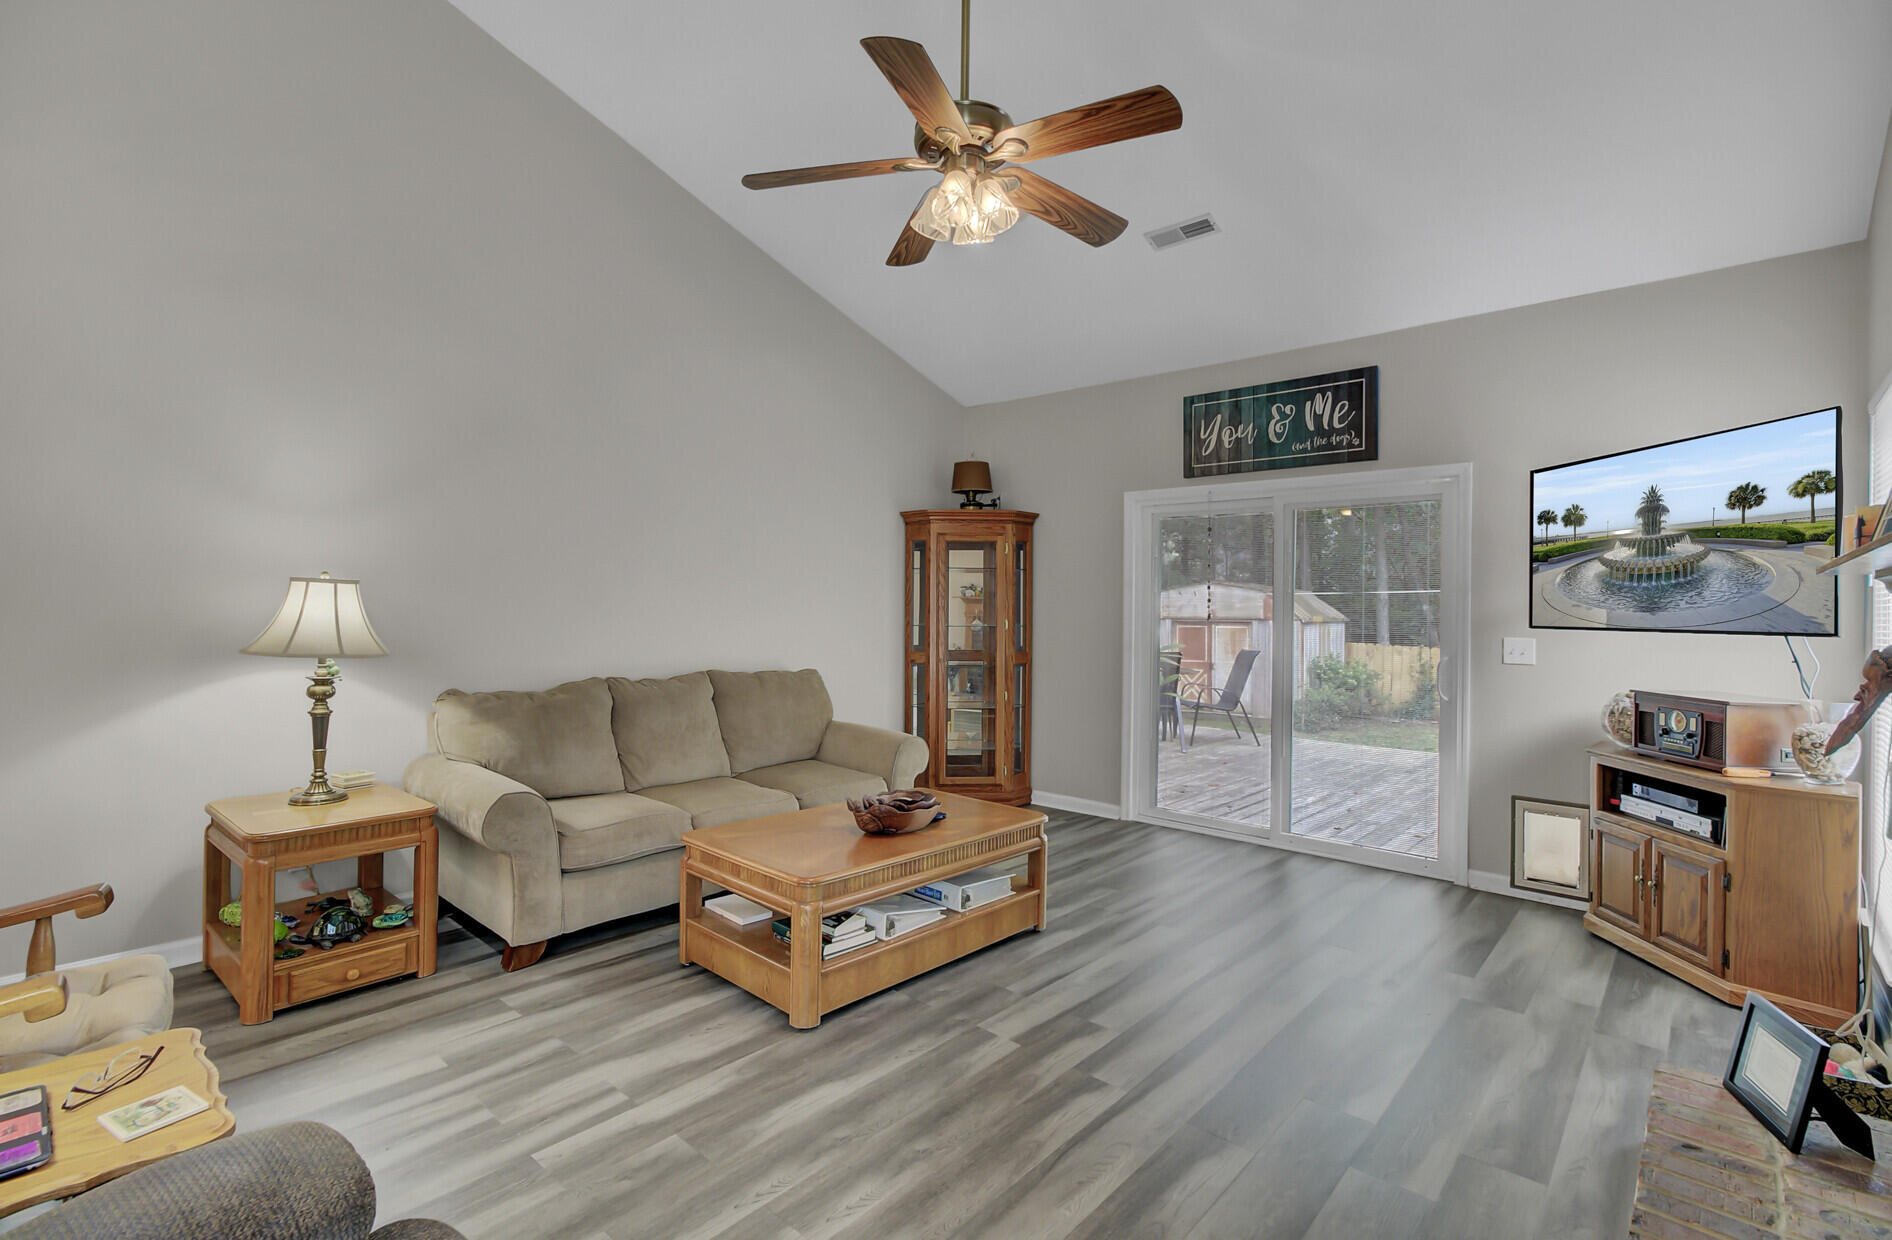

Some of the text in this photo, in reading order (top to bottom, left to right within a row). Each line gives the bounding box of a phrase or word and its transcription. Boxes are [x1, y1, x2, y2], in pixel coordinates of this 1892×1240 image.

[1200, 391, 1355, 456] You & Me
[1313, 435, 1328, 448] the
